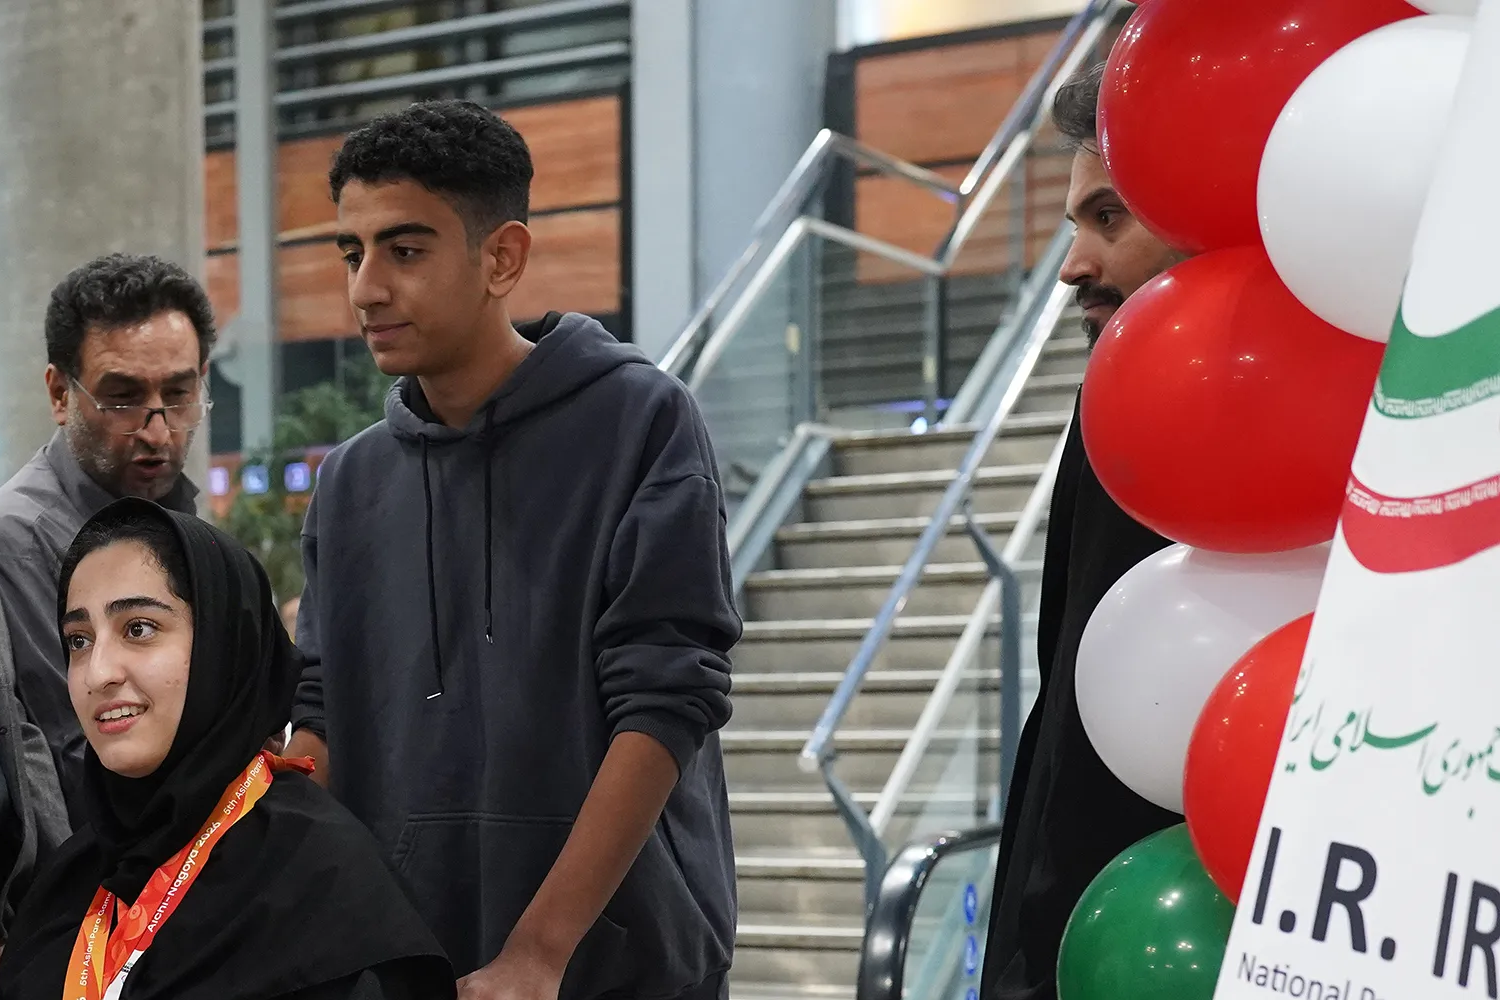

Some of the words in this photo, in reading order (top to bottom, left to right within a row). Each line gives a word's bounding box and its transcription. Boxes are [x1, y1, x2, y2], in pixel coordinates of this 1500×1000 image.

[147, 849, 199, 933] Aichi-Nagoya
[196, 820, 222, 848] 2026
[223, 799, 238, 815] 5th
[236, 776, 255, 800] Asian
[250, 761, 263, 778] Para
[1252, 826, 1397, 962] I.R.
[90, 917, 102, 940] Para
[82, 941, 95, 967] Asian
[80, 965, 89, 986] 5th
